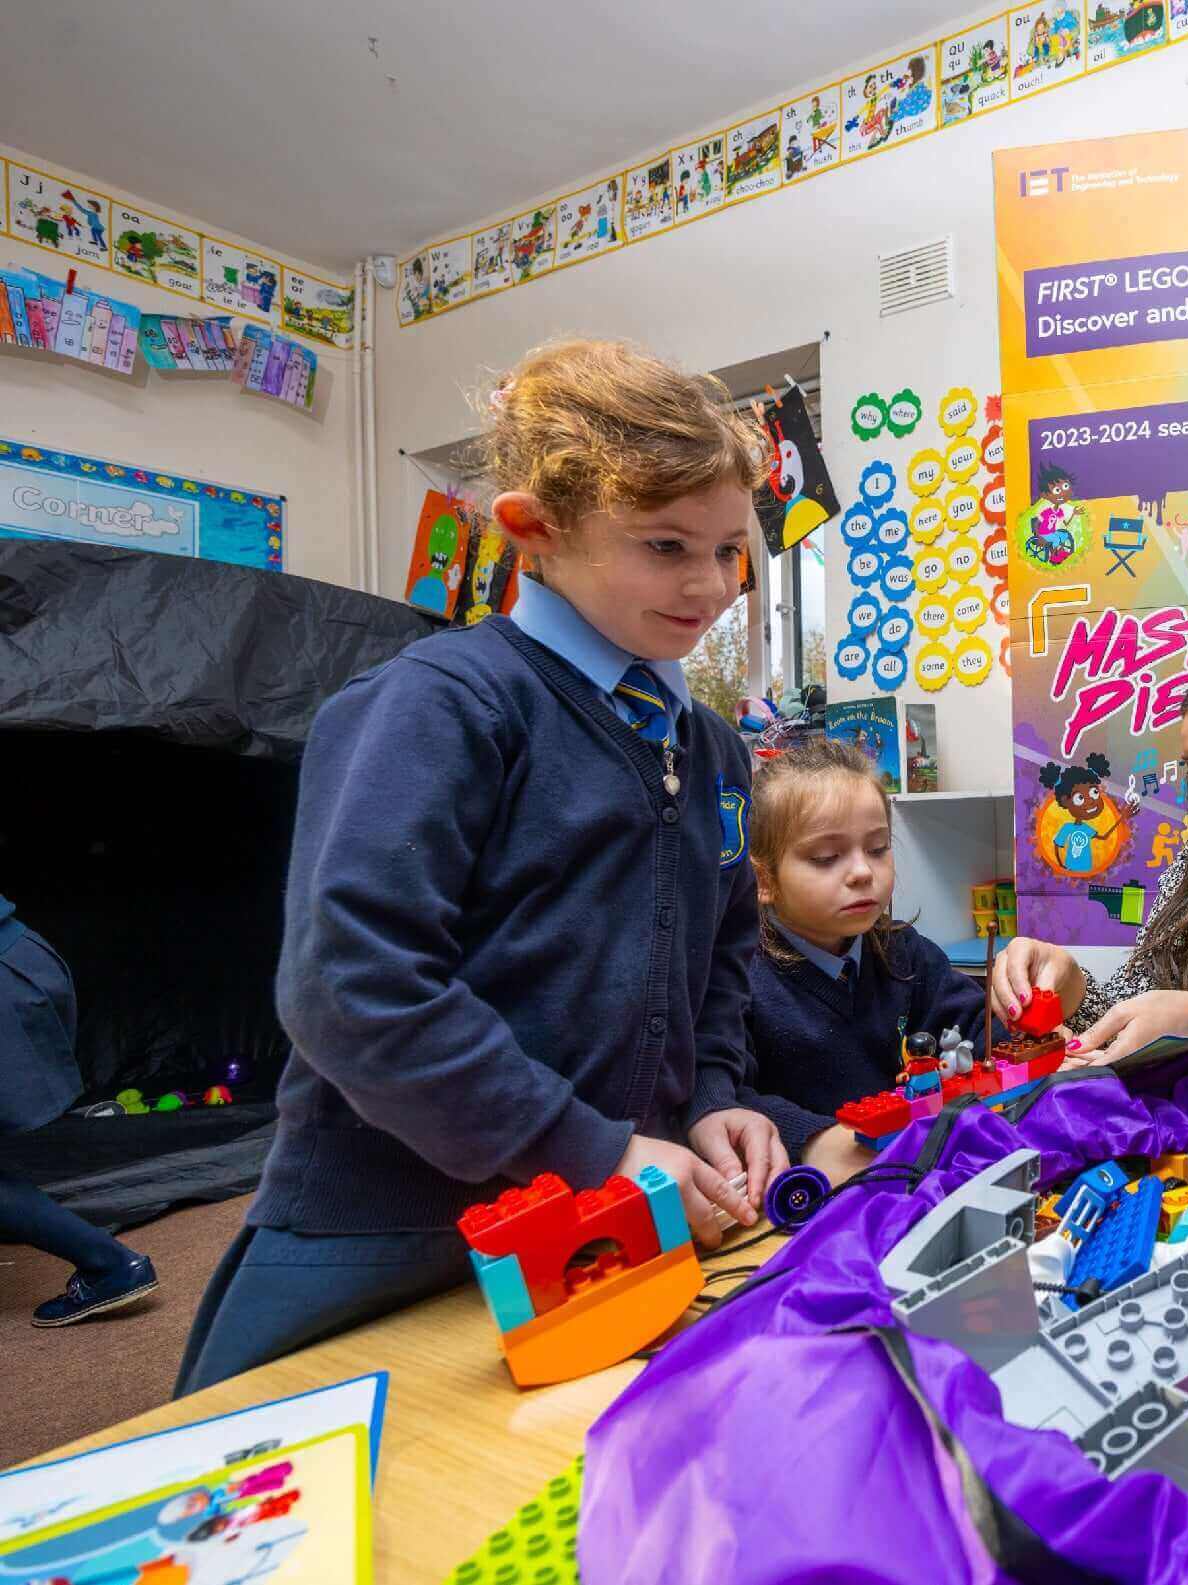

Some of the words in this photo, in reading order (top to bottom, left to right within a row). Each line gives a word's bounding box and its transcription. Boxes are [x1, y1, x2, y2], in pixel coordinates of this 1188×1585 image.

[1015, 15, 1031, 26] ou
[949, 42, 965, 56] QU
[1093, 49, 1105, 62] oil
[948, 59, 961, 71] qu
[880, 69, 893, 83] th
[1017, 72, 1043, 92] ouch!
[978, 88, 1006, 107] quack
[786, 108, 797, 120] sh
[895, 116, 923, 137] thumb
[19, 174, 31, 186] J
[1020, 167, 1069, 197] IET
[75, 244, 100, 260] jam
[168, 277, 192, 291] goat
[1038, 308, 1139, 338] Discover
[860, 410, 878, 425] why
[892, 408, 915, 419] where
[948, 402, 967, 419] said
[1041, 420, 1151, 450] 2023-2024
[951, 453, 974, 469] your
[918, 468, 935, 482] my
[13, 486, 152, 531] Corner
[952, 503, 974, 519] you
[850, 518, 868, 531] the
[917, 514, 938, 525] here
[884, 526, 901, 537] me
[859, 558, 872, 570] be
[955, 552, 970, 566] no
[924, 562, 938, 578] go
[888, 573, 908, 584] was
[858, 611, 872, 621] we
[922, 611, 945, 622] there
[956, 603, 981, 617] come
[888, 623, 902, 636] do
[843, 653, 860, 663] are
[961, 655, 983, 668] they
[883, 659, 897, 672] all
[921, 662, 946, 673] some
